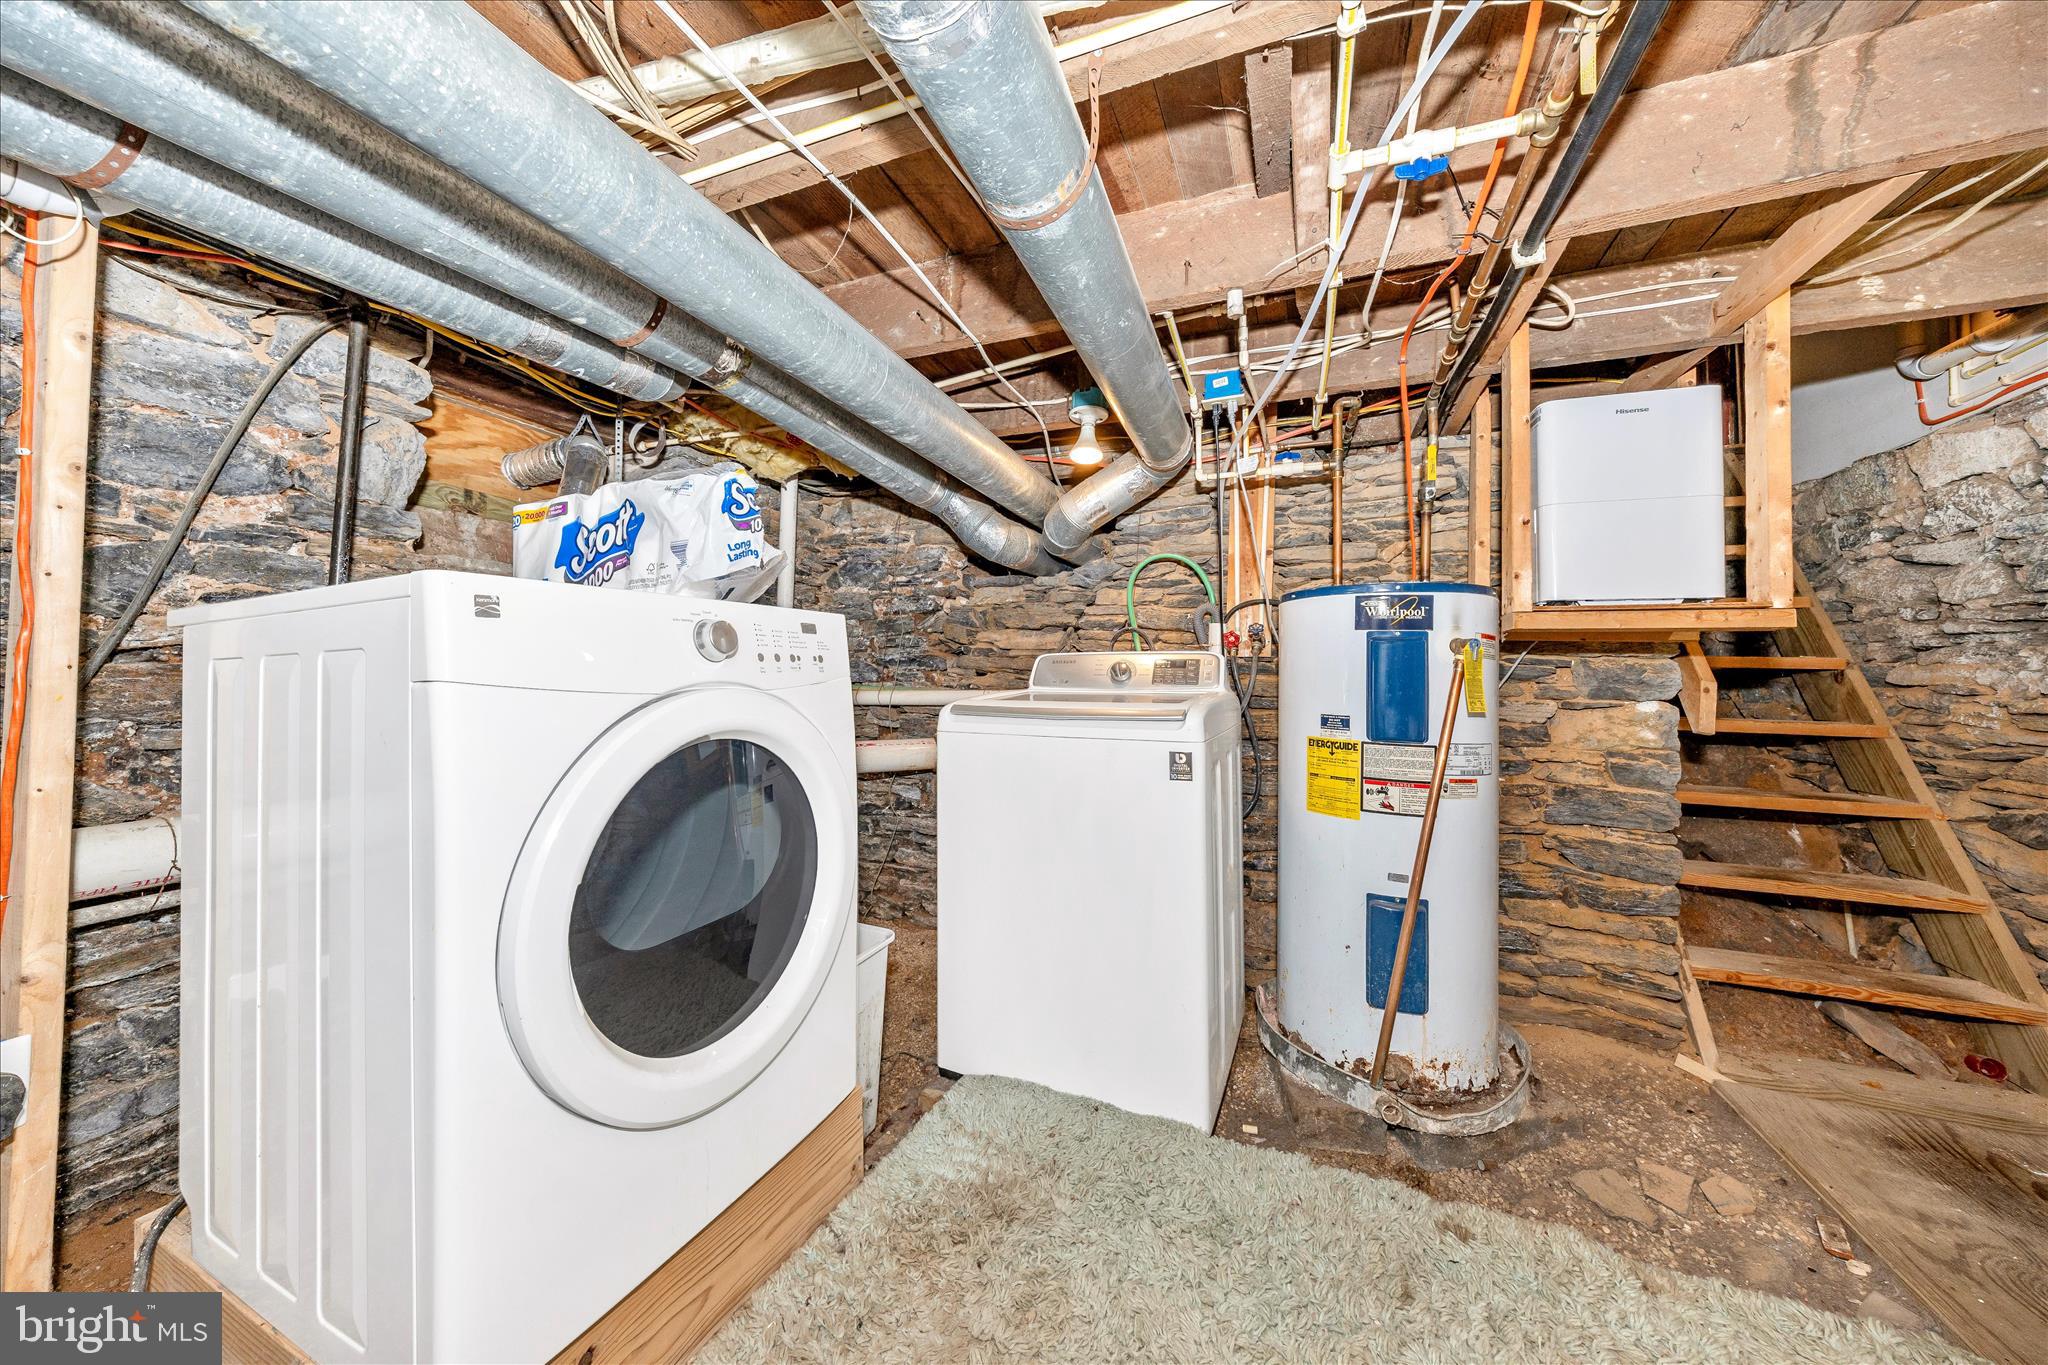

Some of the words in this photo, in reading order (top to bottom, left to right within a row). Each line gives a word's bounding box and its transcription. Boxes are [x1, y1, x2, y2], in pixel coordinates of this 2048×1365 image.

[571, 500, 634, 574] Scott
[727, 540, 751, 551] Long
[727, 548, 759, 562] Lasting
[1365, 606, 1426, 620] Whirlpool
